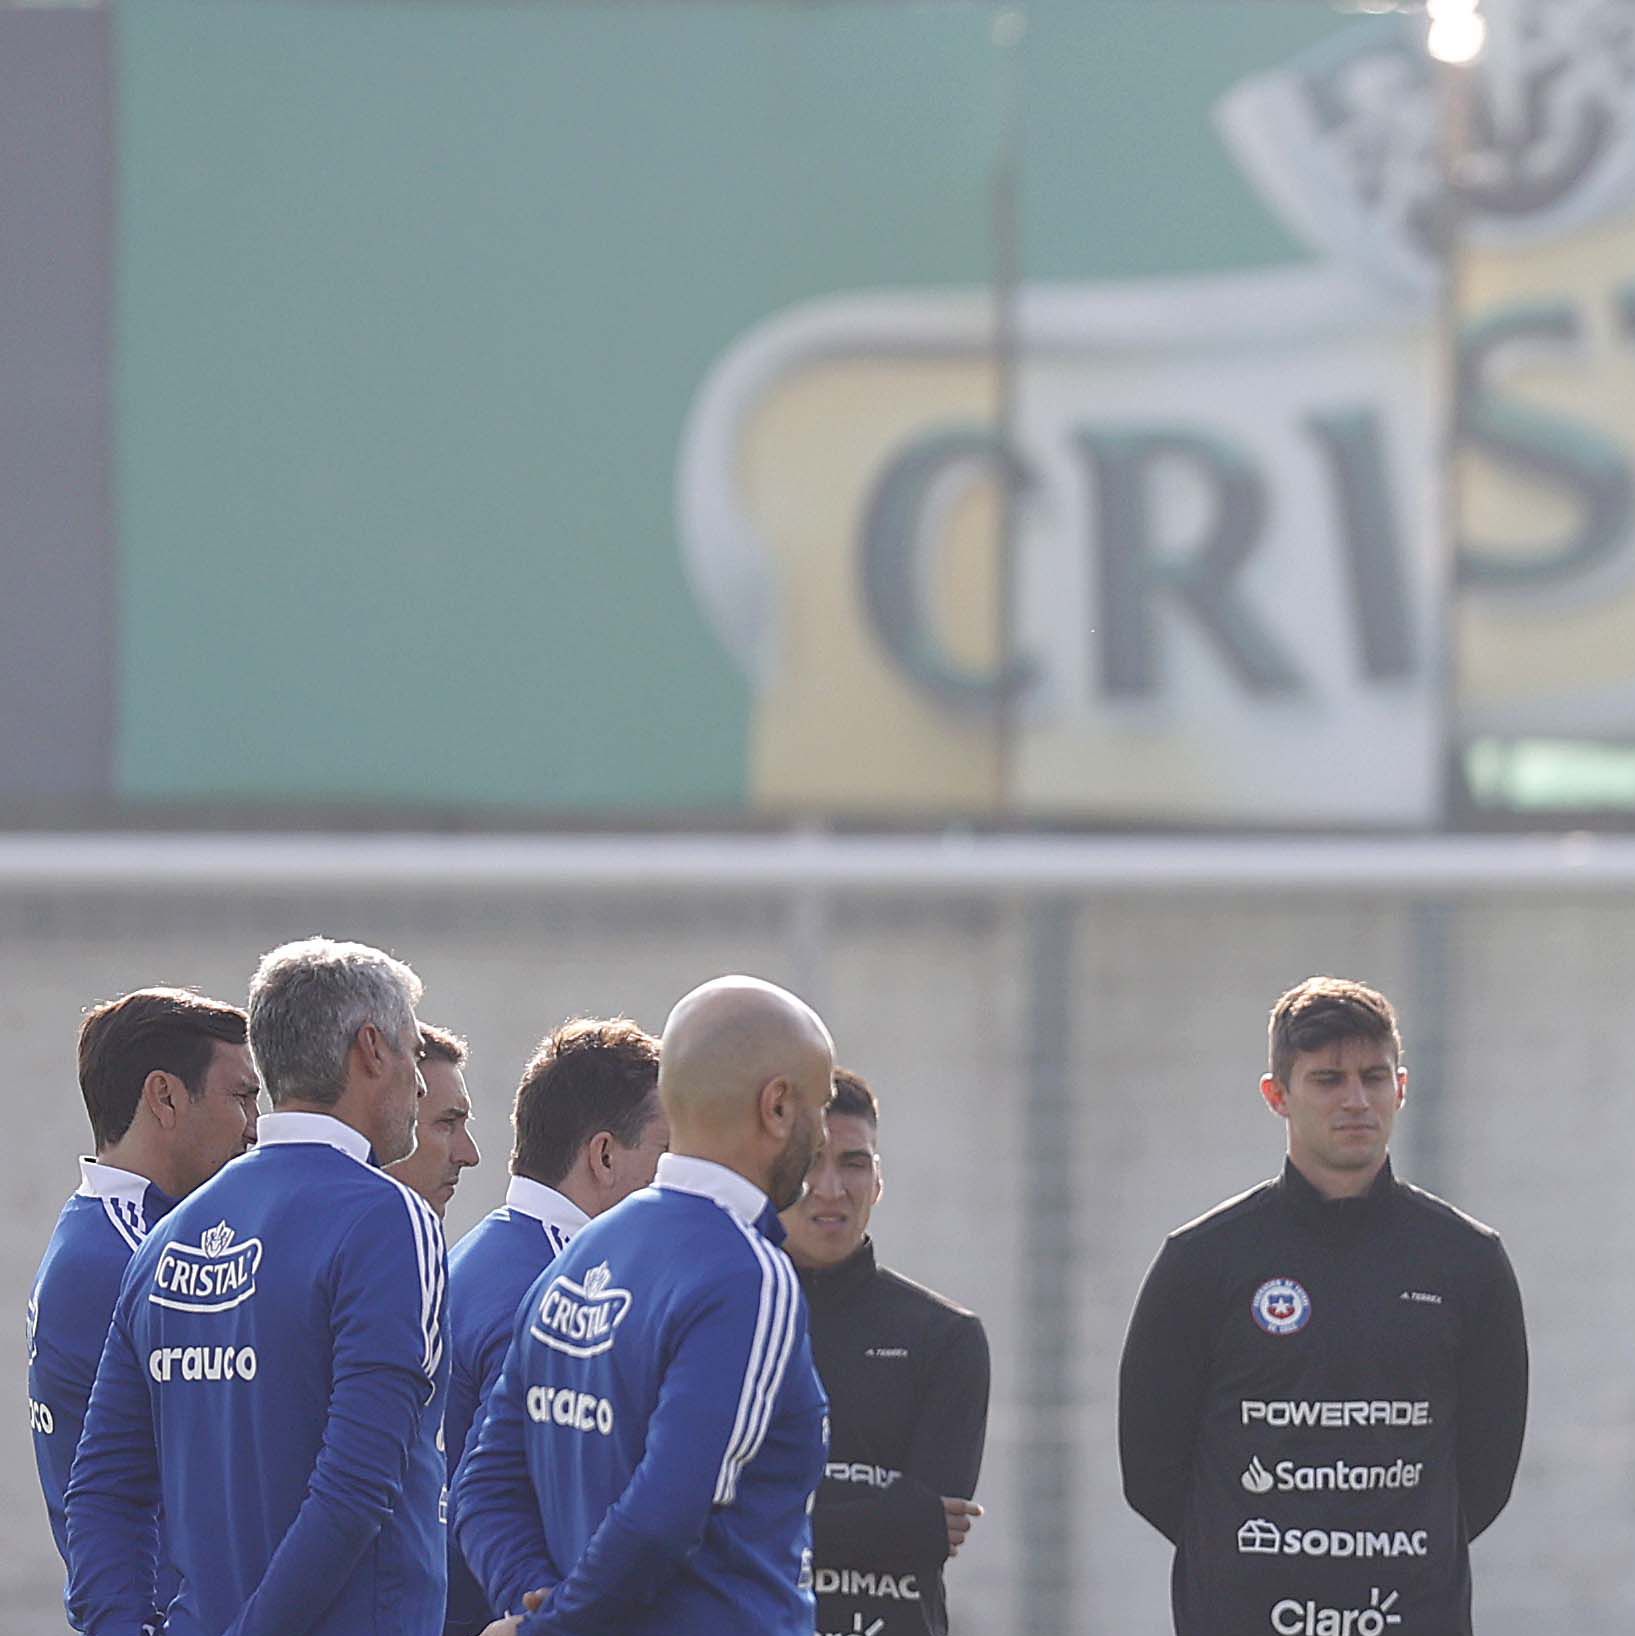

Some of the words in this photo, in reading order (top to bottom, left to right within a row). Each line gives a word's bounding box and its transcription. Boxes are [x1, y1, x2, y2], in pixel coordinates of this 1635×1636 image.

[157, 1257, 249, 1296] CRISTAL
[541, 1293, 612, 1341] CRISTAL
[1241, 1400, 1429, 1426] POWERADE
[1276, 1459, 1423, 1491] Santander
[1283, 1536, 1427, 1557] SODIMAC
